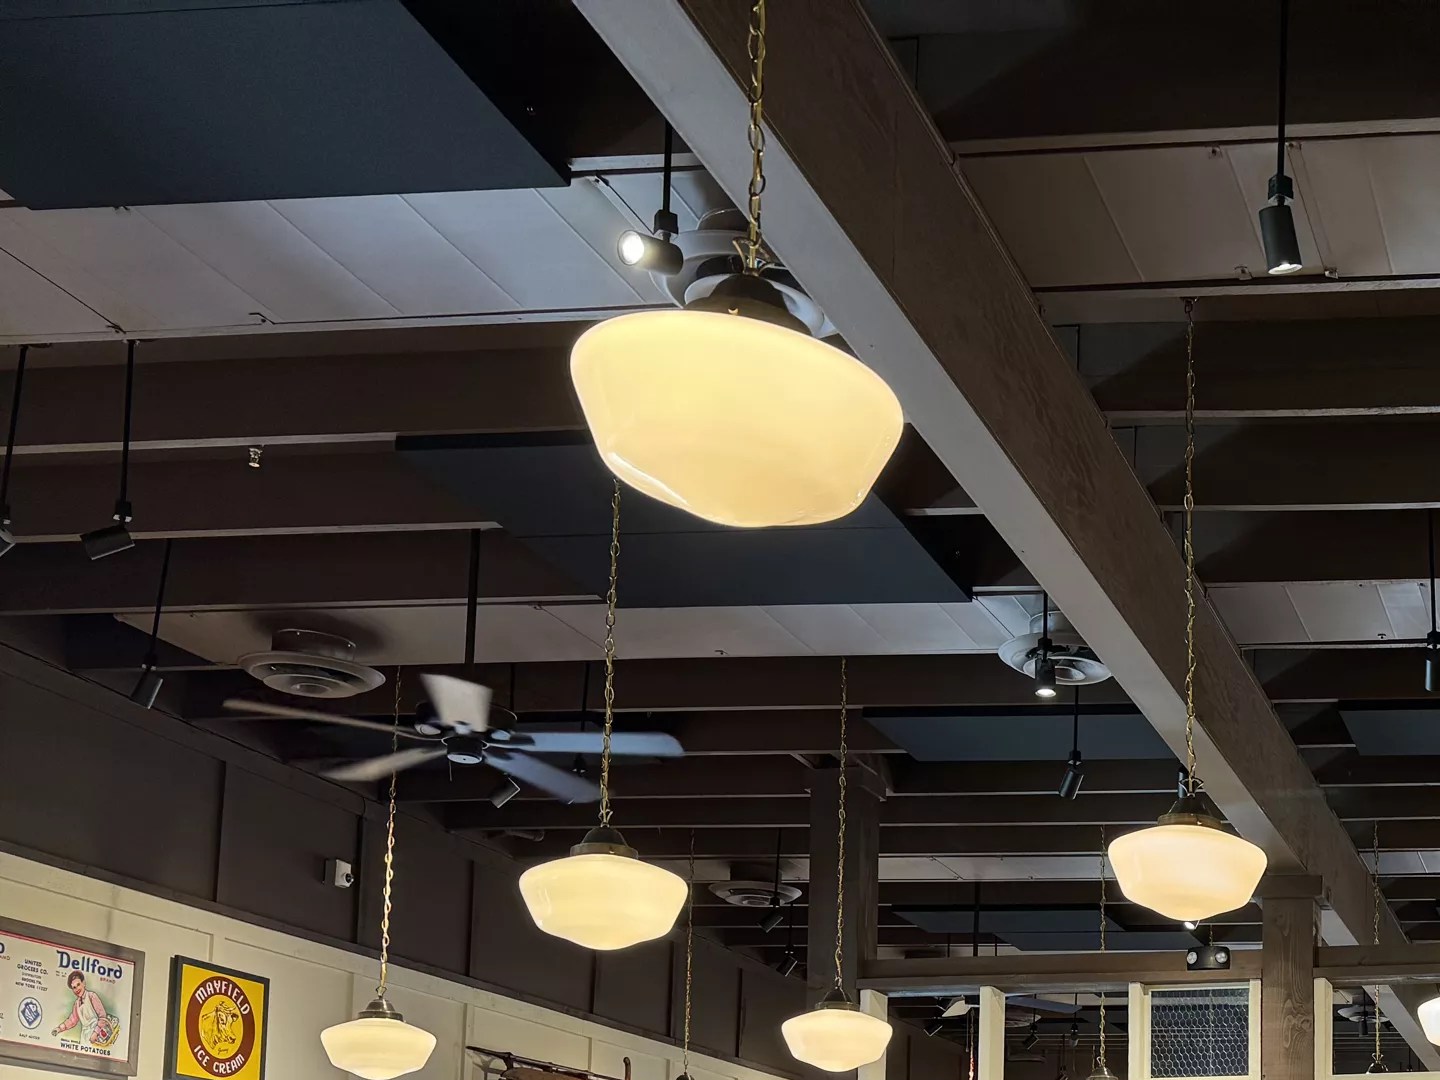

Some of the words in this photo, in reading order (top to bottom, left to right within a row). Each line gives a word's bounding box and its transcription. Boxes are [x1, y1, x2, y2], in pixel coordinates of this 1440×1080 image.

[24, 958, 42, 967] UNITED
[56, 950, 123, 979] Dellford
[194, 980, 250, 1015] MAYFIELD
[60, 1042, 79, 1050] WHITE
[80, 1046, 111, 1056] POTATOES
[194, 1045, 210, 1066] ICE
[212, 1053, 244, 1074] CREAM
